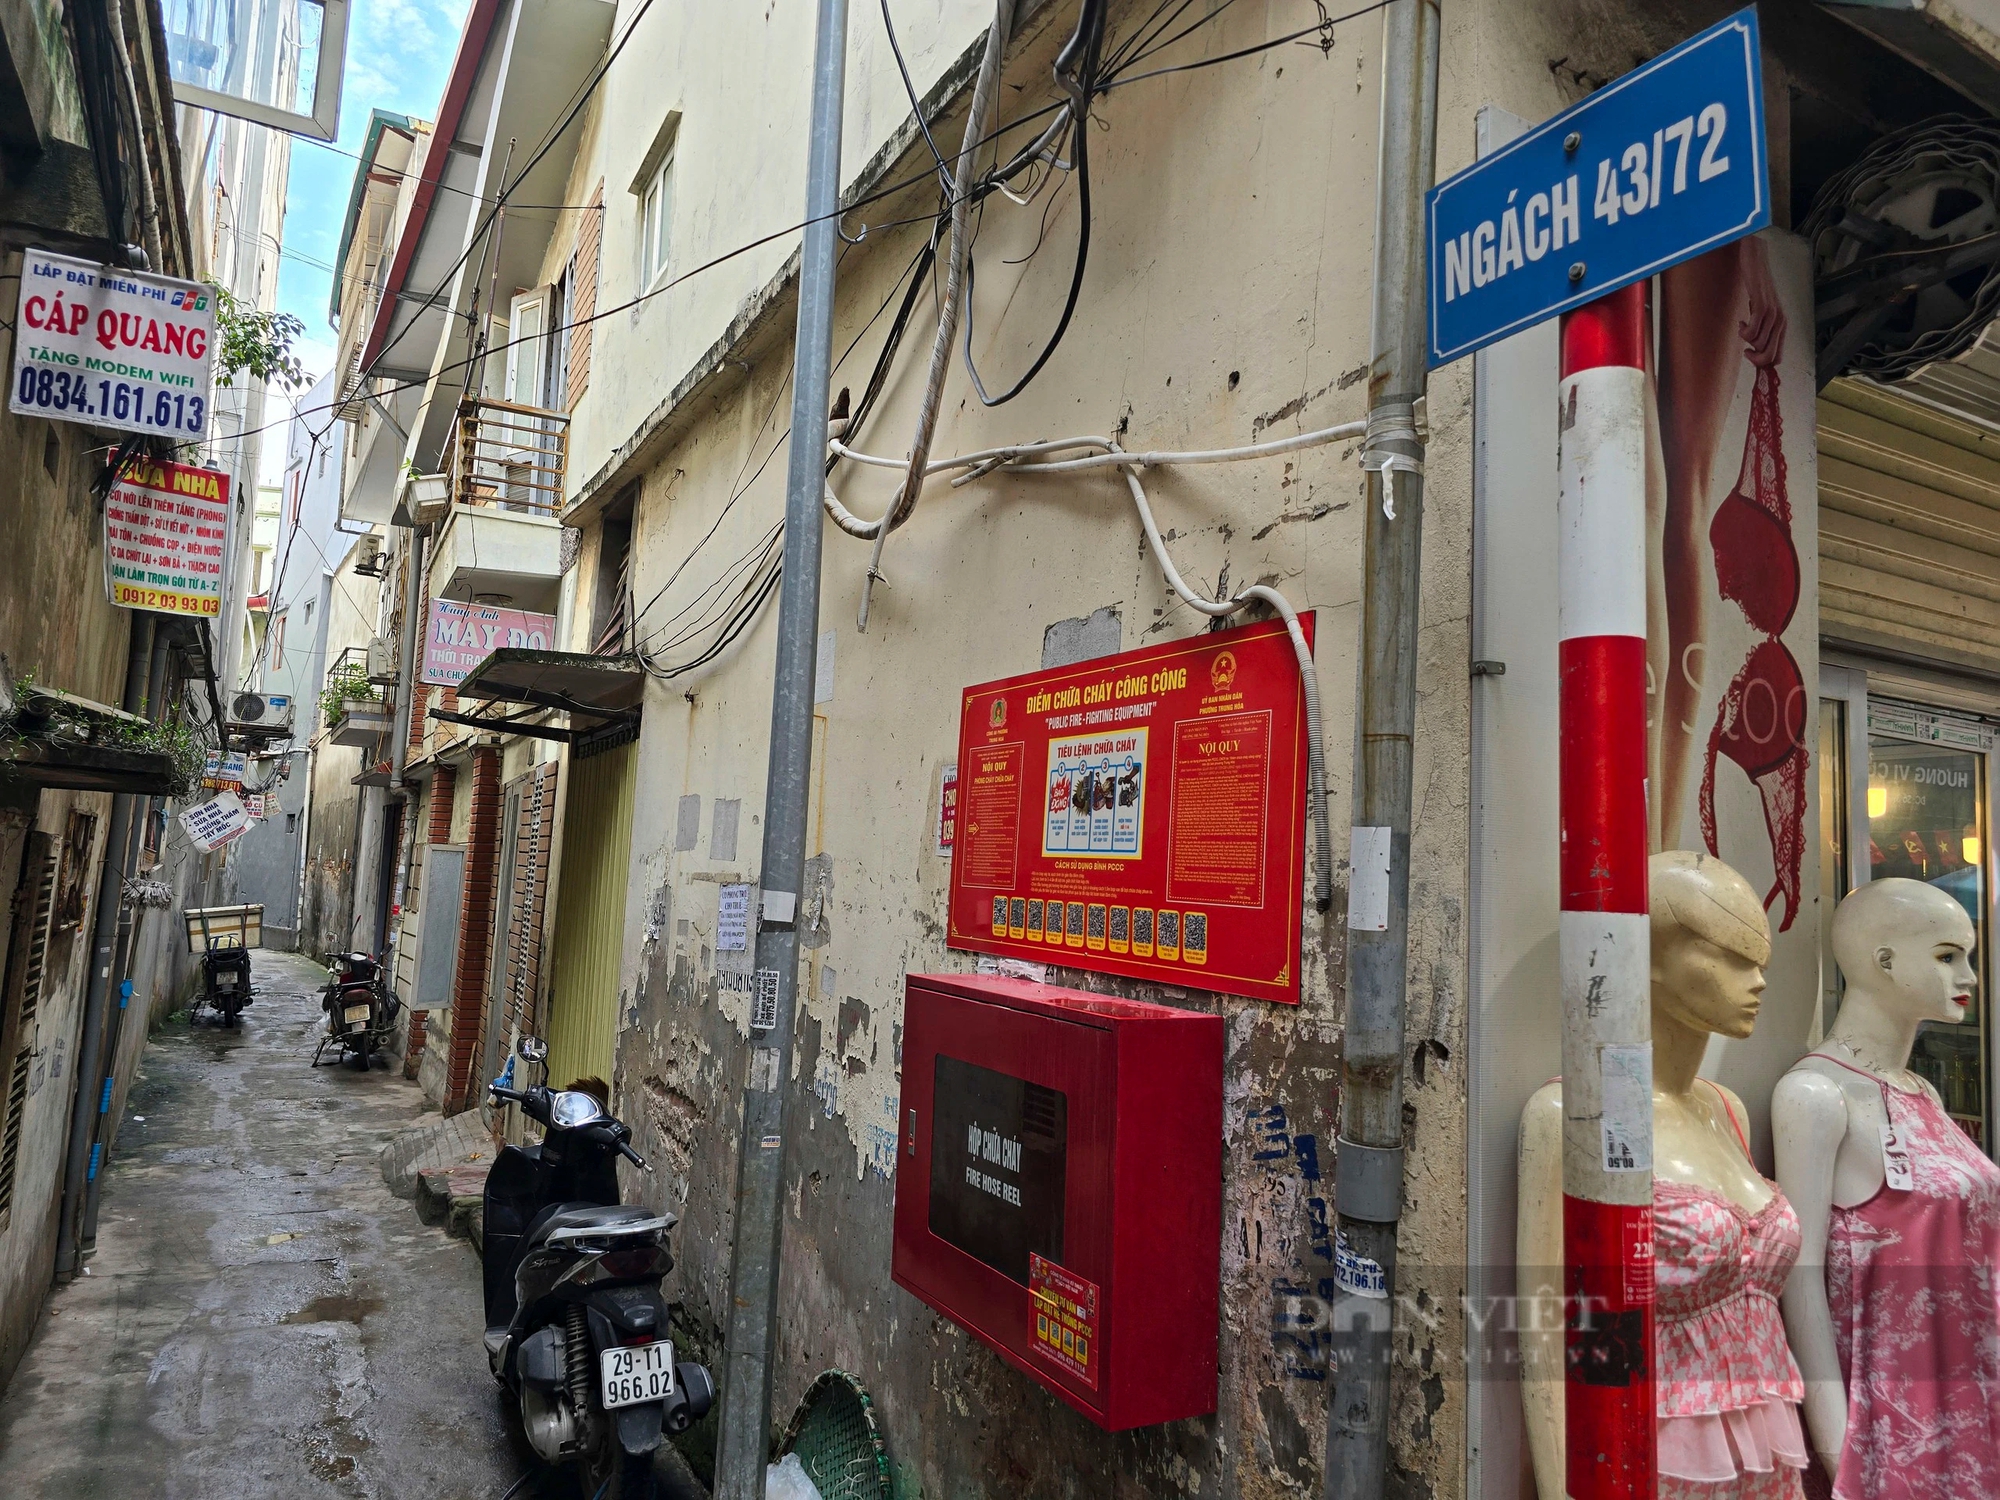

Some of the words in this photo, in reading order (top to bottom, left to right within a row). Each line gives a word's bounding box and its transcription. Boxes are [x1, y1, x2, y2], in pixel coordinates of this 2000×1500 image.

[1444, 174, 1581, 303] NGÁCH
[1593, 102, 1730, 226] 43/72
[33, 263, 63, 279] LẮP
[66, 270, 95, 287] ĐẶT
[141, 286, 166, 301] PHÍ
[170, 291, 210, 312] FPT
[24, 290, 90, 336] CÁP
[96, 309, 207, 360] QUANG
[85, 357, 153, 381] MODEM
[159, 371, 195, 388] WIFI
[19, 366, 205, 433] 0834.161.613
[173, 471, 220, 500] NHÀ
[127, 566, 145, 582] LÀM
[171, 575, 186, 588] GÓI
[122, 588, 156, 606] 0912
[160, 594, 177, 609] 03
[181, 597, 198, 612] 93
[202, 599, 219, 613] 03
[434, 618, 501, 650] MAY
[506, 628, 546, 650] ĐO
[460, 653, 488, 666] TRAN
[1026, 688, 1051, 714] ĐIỂM
[1053, 687, 1081, 710] CHỮA
[1084, 680, 1113, 704] CHÁY
[1115, 675, 1148, 699] CÔNG
[1151, 667, 1187, 696] CỘNG
[1057, 744, 1072, 758] TIÊU
[1073, 743, 1092, 758] LỆNH
[1093, 739, 1114, 755] CHỮA
[1115, 737, 1137, 752] CHÁY
[1198, 741, 1216, 756] NỘI
[1218, 740, 1241, 755] QUY
[994, 761, 1007, 772] QUY
[967, 1120, 982, 1162] HỘP
[982, 1126, 1001, 1166] CHỮA
[1002, 1135, 1022, 1173] CHÁY
[965, 1166, 981, 1187] FIRE
[982, 1173, 1001, 1198] HOSE
[1002, 1182, 1022, 1207] REEL
[613, 1346, 662, 1376] 29-T1
[608, 1370, 671, 1404] 966.02
